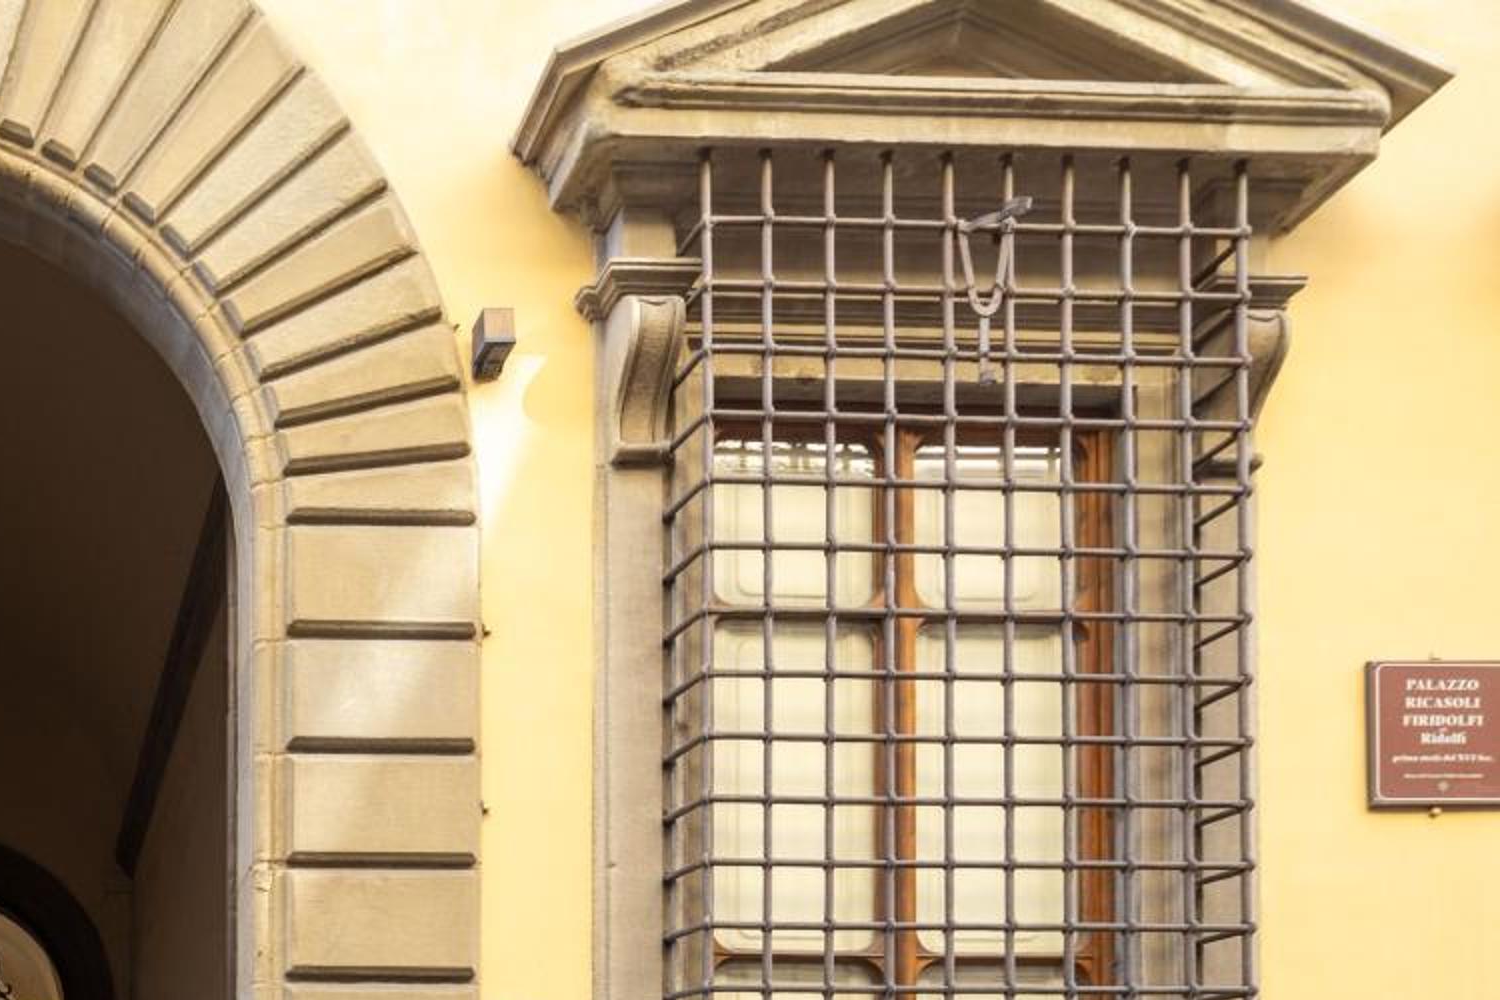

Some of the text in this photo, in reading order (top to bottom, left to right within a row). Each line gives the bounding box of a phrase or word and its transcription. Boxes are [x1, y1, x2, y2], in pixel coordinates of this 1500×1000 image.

[1406, 678, 1480, 691] PALAZZO
[1405, 697, 1480, 709] RICASOLI
[1402, 715, 1484, 727] FIRIDOLFI
